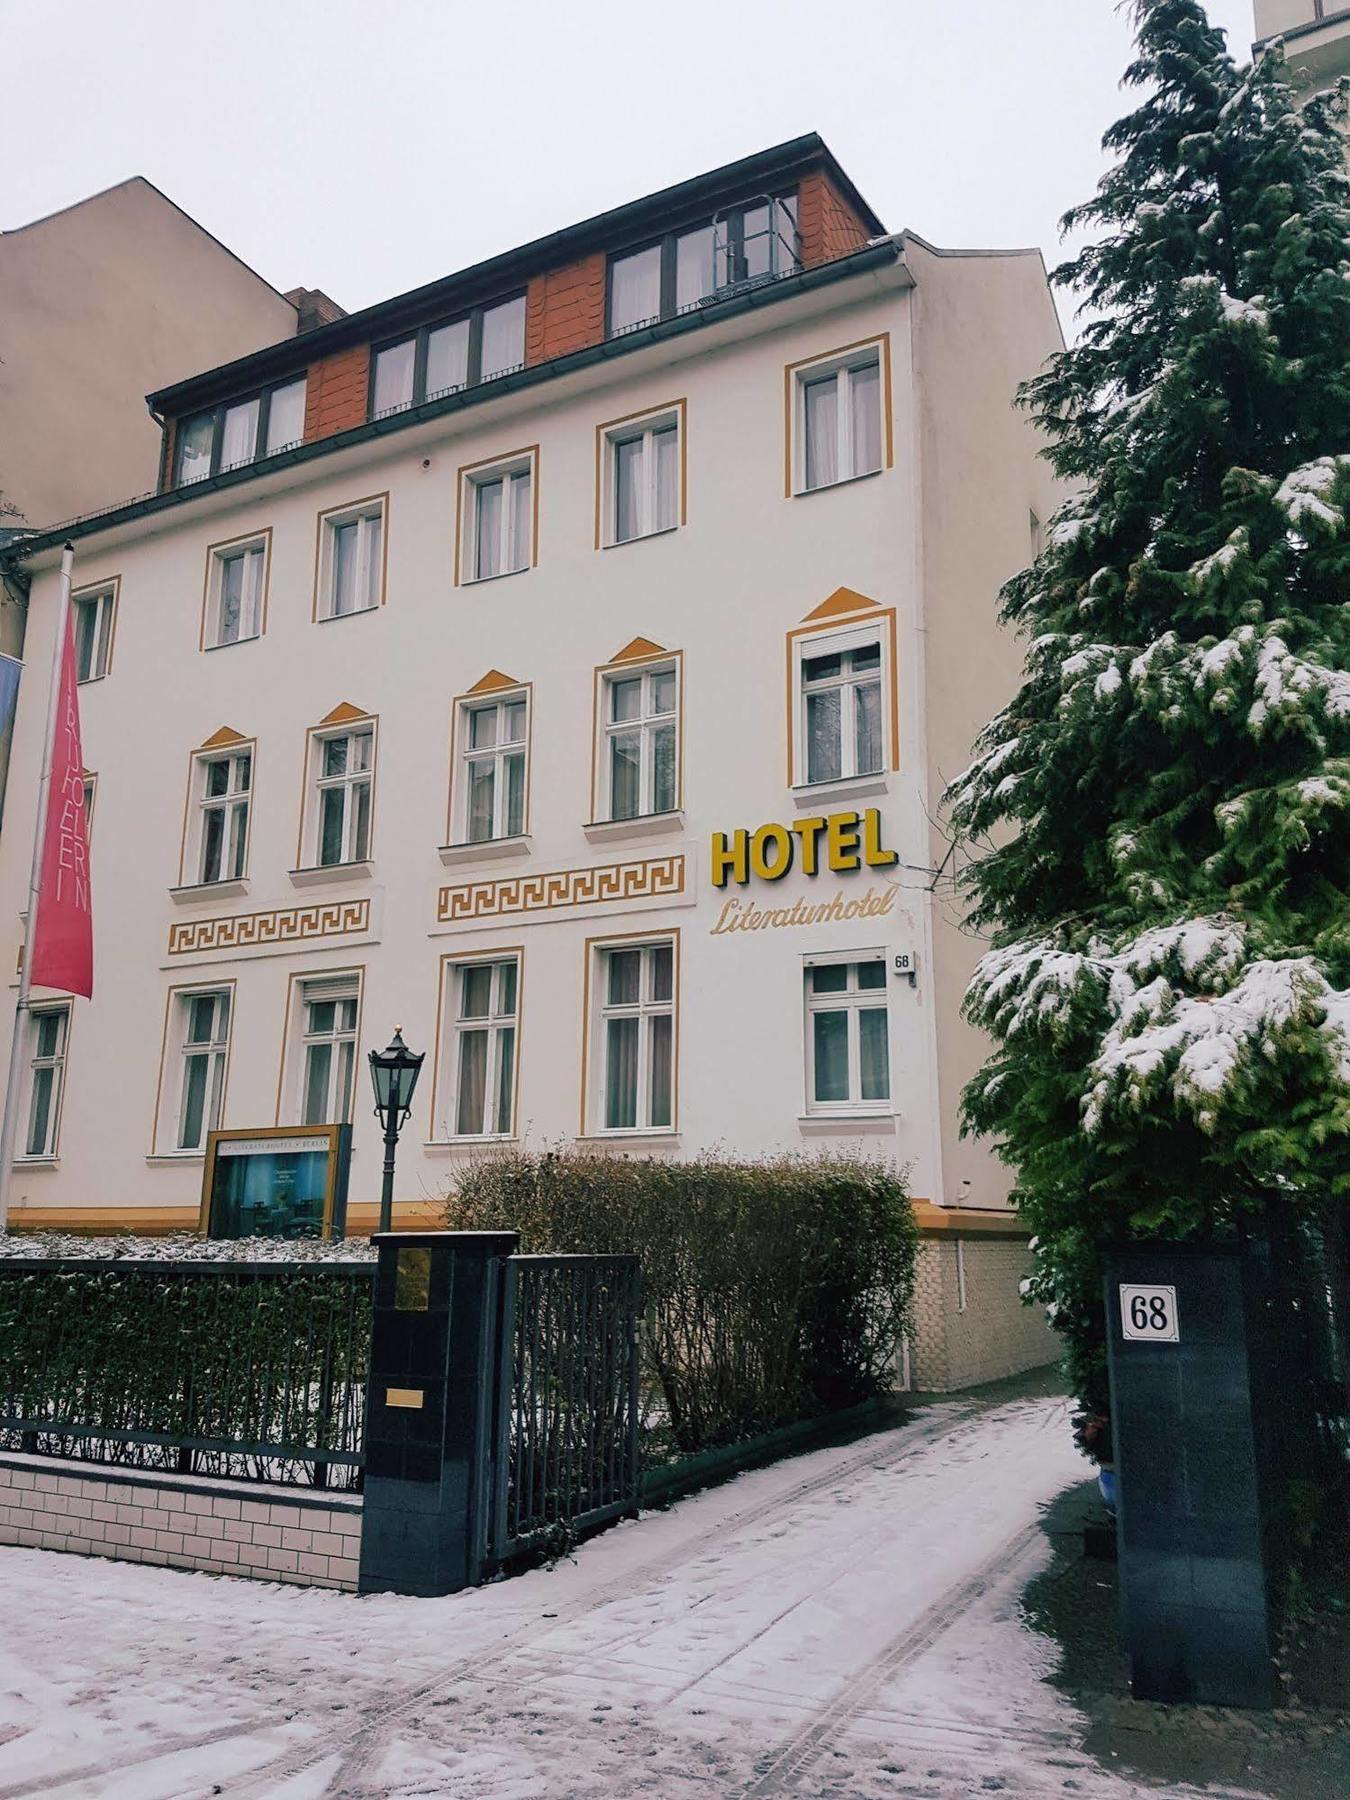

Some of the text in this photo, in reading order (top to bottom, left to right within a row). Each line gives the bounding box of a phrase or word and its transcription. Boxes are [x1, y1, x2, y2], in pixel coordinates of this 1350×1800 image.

[712, 808, 898, 887] HOTEL
[710, 885, 898, 935] Literaturhotel
[895, 955, 909, 968] 68
[1131, 1295, 1168, 1330] 68
